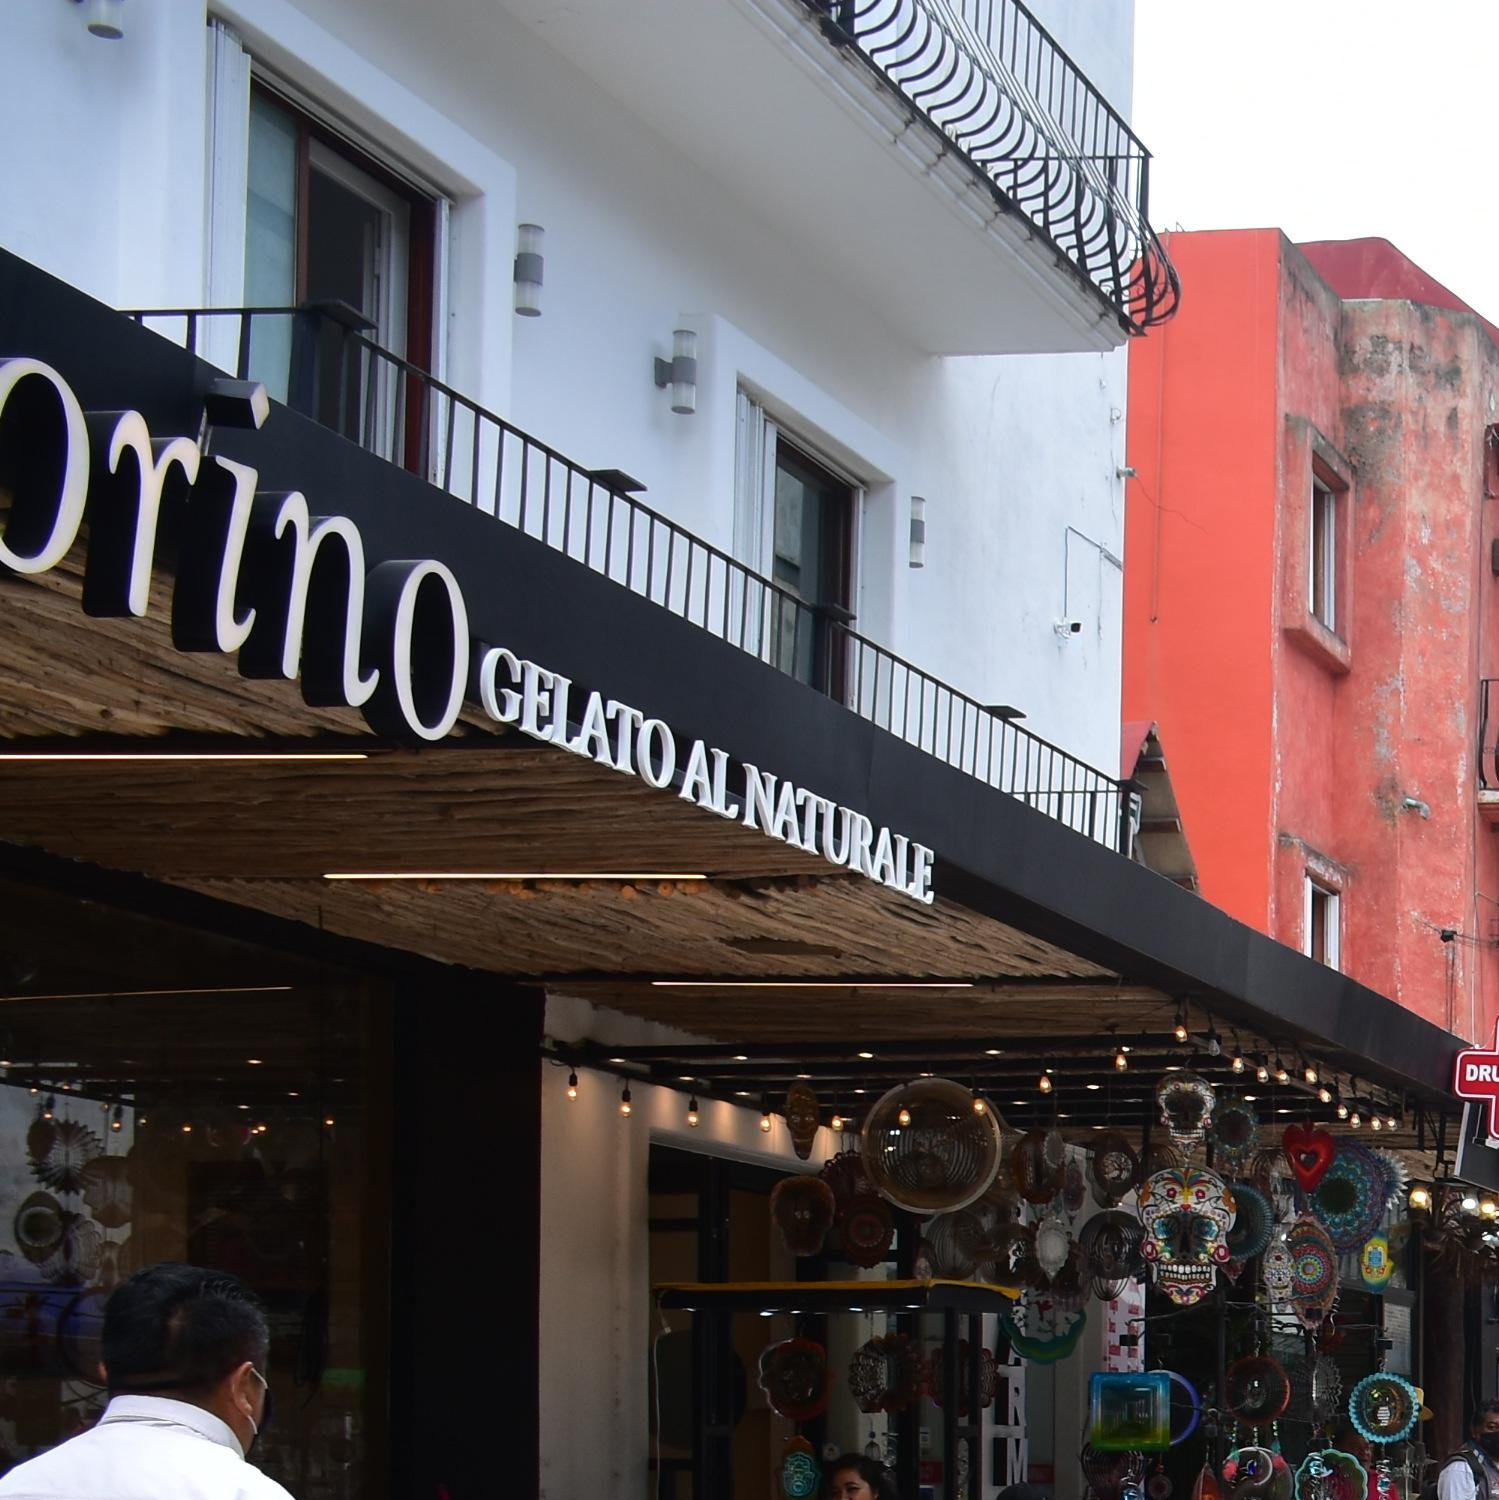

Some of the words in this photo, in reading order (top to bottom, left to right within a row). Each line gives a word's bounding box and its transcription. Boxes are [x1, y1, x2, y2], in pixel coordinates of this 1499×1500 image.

[479, 647, 677, 789] GELATO
[679, 740, 739, 821] AL
[741, 763, 936, 906] NATURALE
